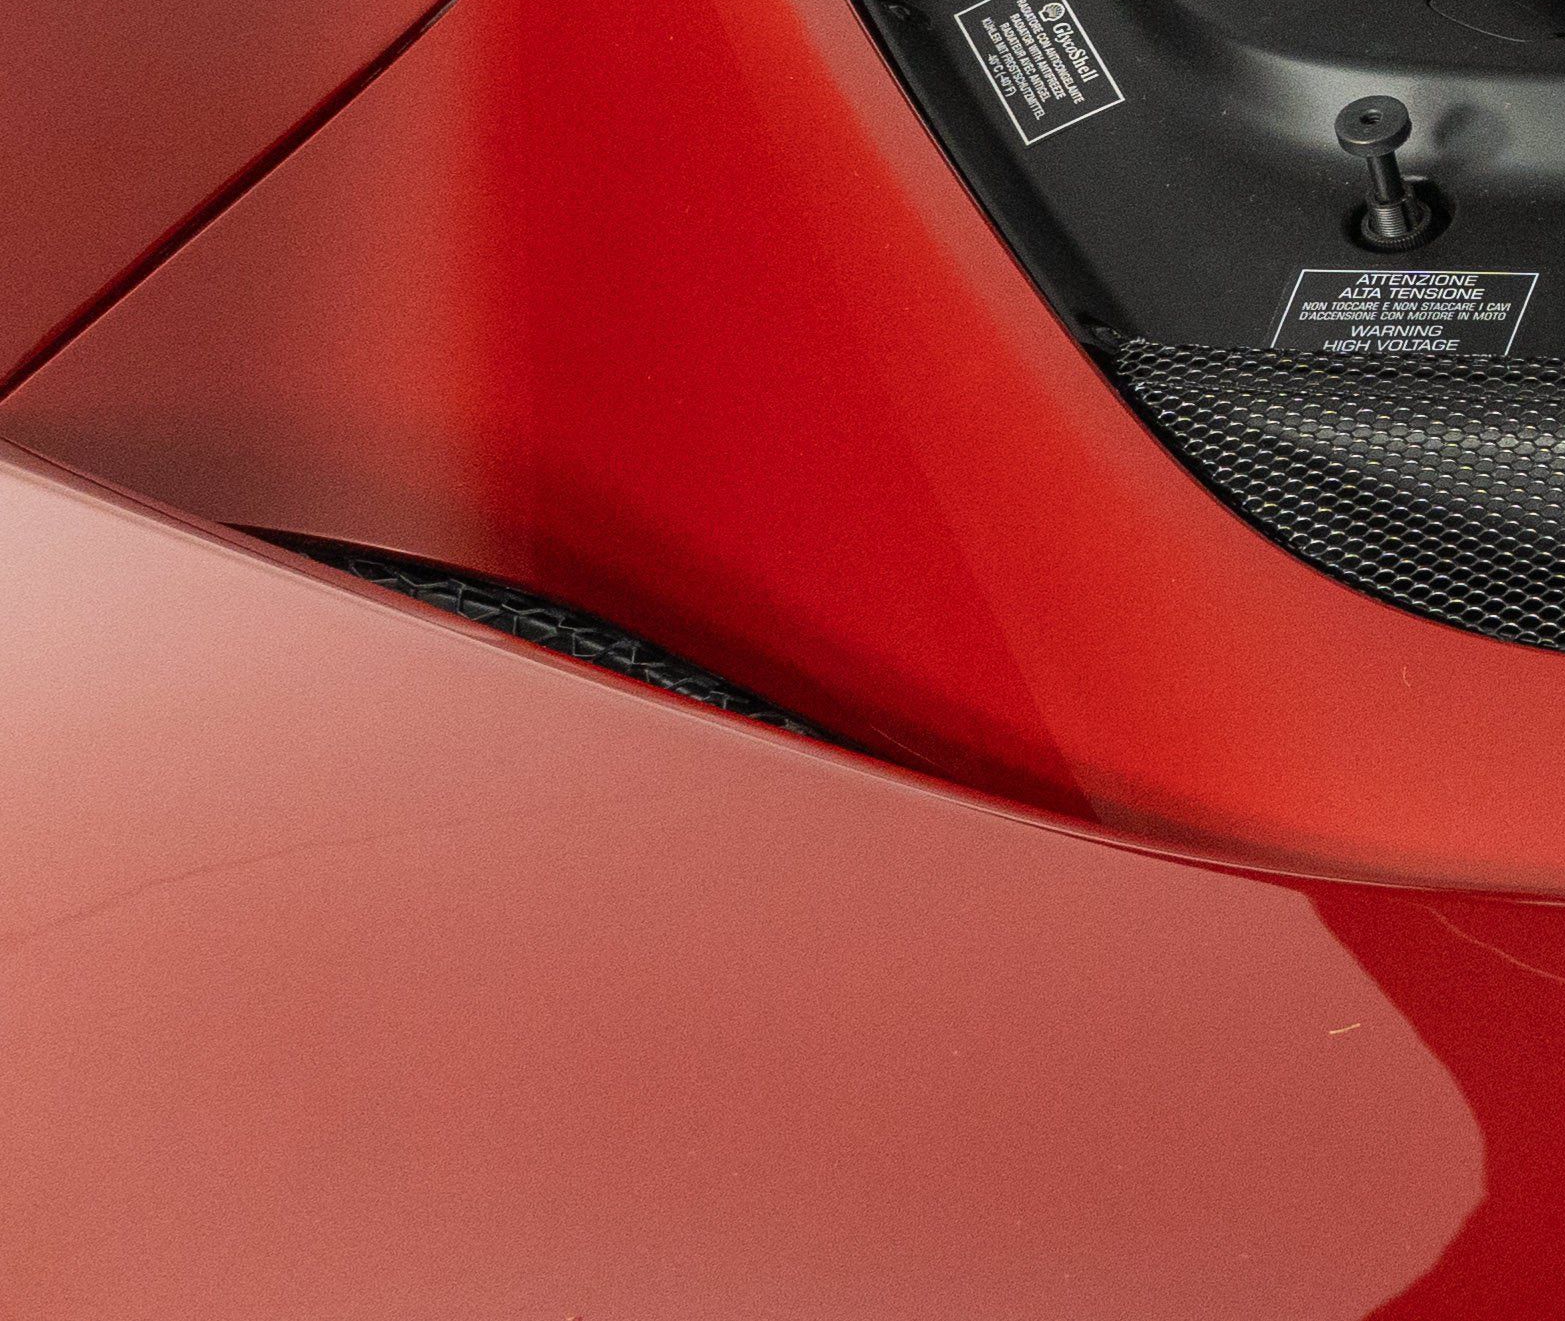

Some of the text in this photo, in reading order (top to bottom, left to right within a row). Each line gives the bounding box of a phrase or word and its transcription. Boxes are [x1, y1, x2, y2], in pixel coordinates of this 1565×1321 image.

[1010, 13, 1066, 100] RADIATOR WITH ANTIFREEZE
[1053, 23, 1099, 83] GlycoShell
[999, 22, 1051, 103] RADIATEUR AVEC ANTIGEL
[1036, 33, 1052, 48] CON
[1044, 48, 1085, 104] ANTICONGELANTE
[995, 42, 1009, 54] MIT
[1002, 53, 1045, 120] FROSTSCHUTZMITTEL
[1356, 274, 1479, 286] ATTENZIONE
[1339, 288, 1485, 300] ALTA TENSIONE
[1302, 302, 1327, 310] NON
[1331, 302, 1379, 310] TOCCARE
[1382, 302, 1388, 310] E
[1392, 302, 1417, 311] NON
[1421, 303, 1475, 311] STACCARE
[1487, 303, 1511, 311] CAVI
[1299, 312, 1506, 321] D'ACCENSIONE CON MOTORE IN MOTO
[1351, 325, 1443, 337] WARNING
[1323, 340, 1460, 351] HIGH VOLTAGE
